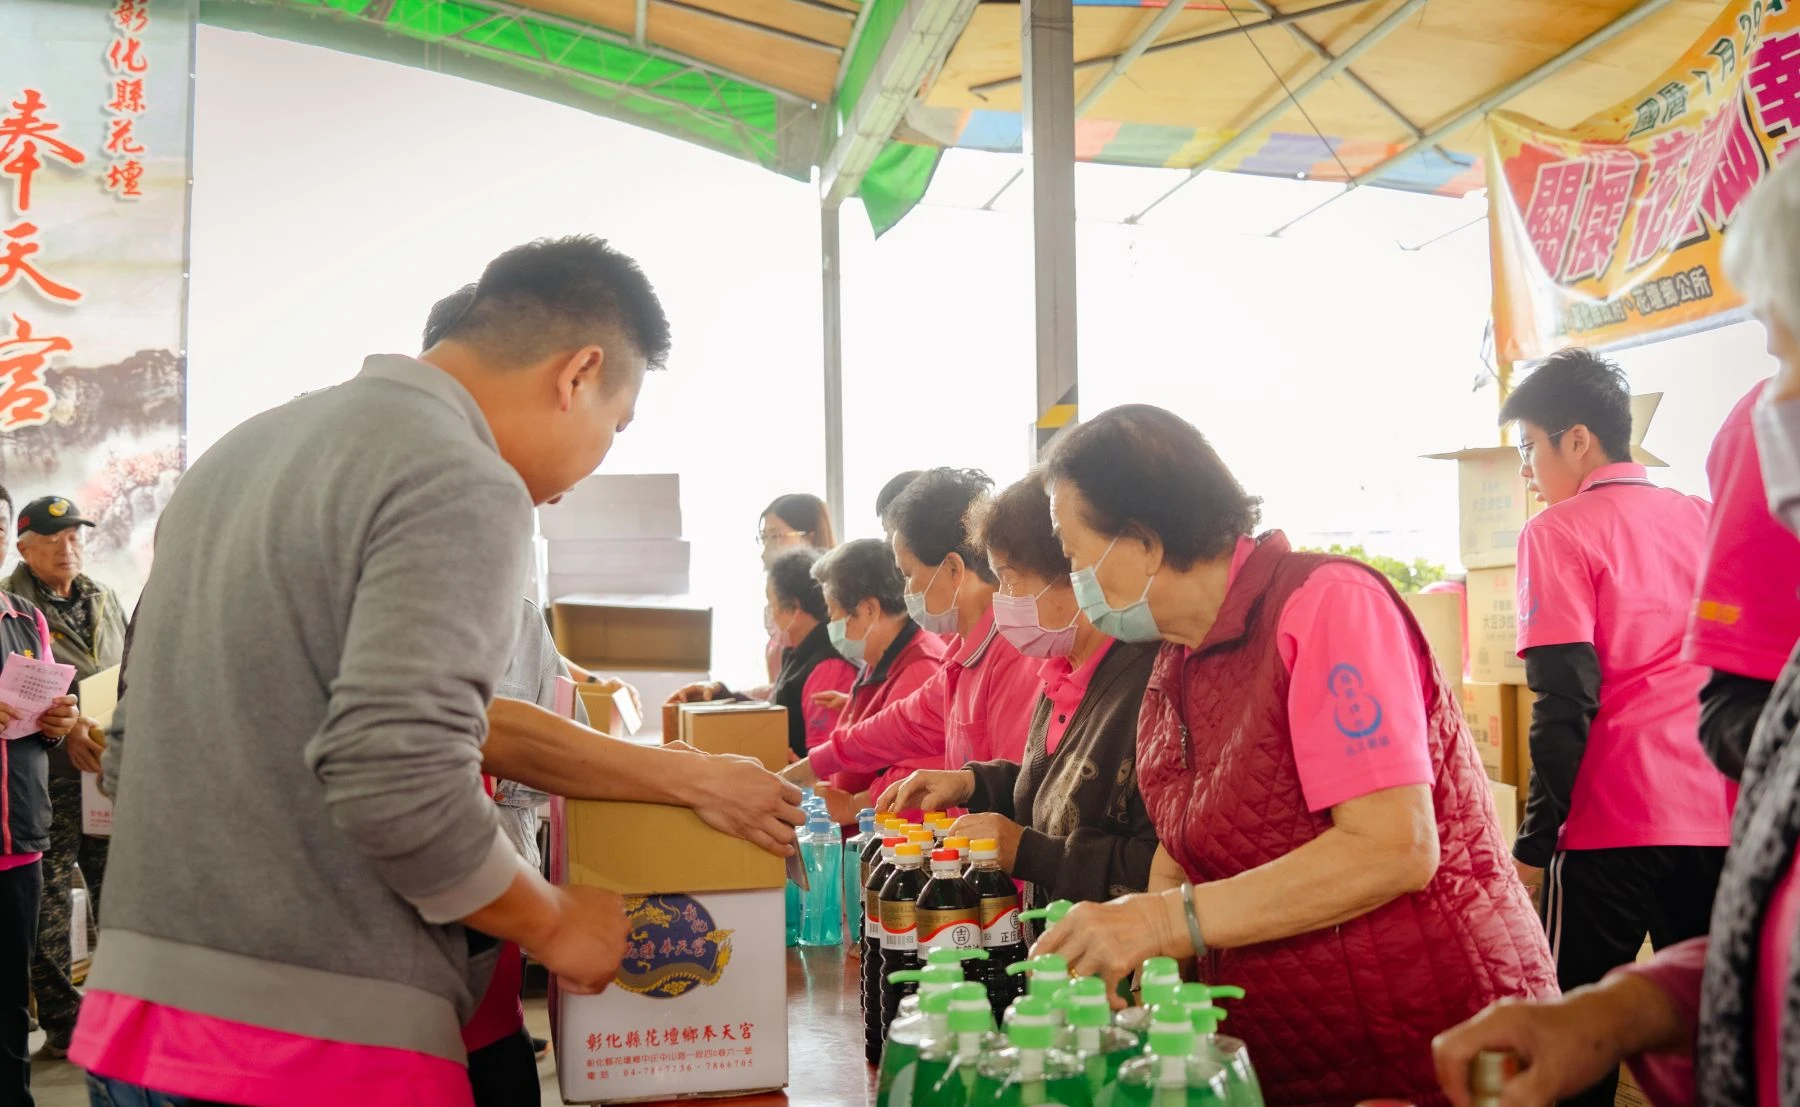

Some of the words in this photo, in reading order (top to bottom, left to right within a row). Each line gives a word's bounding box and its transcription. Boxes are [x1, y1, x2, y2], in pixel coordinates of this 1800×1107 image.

[586, 1022, 754, 1051] 彰化縣花壇鄉奉天宮
